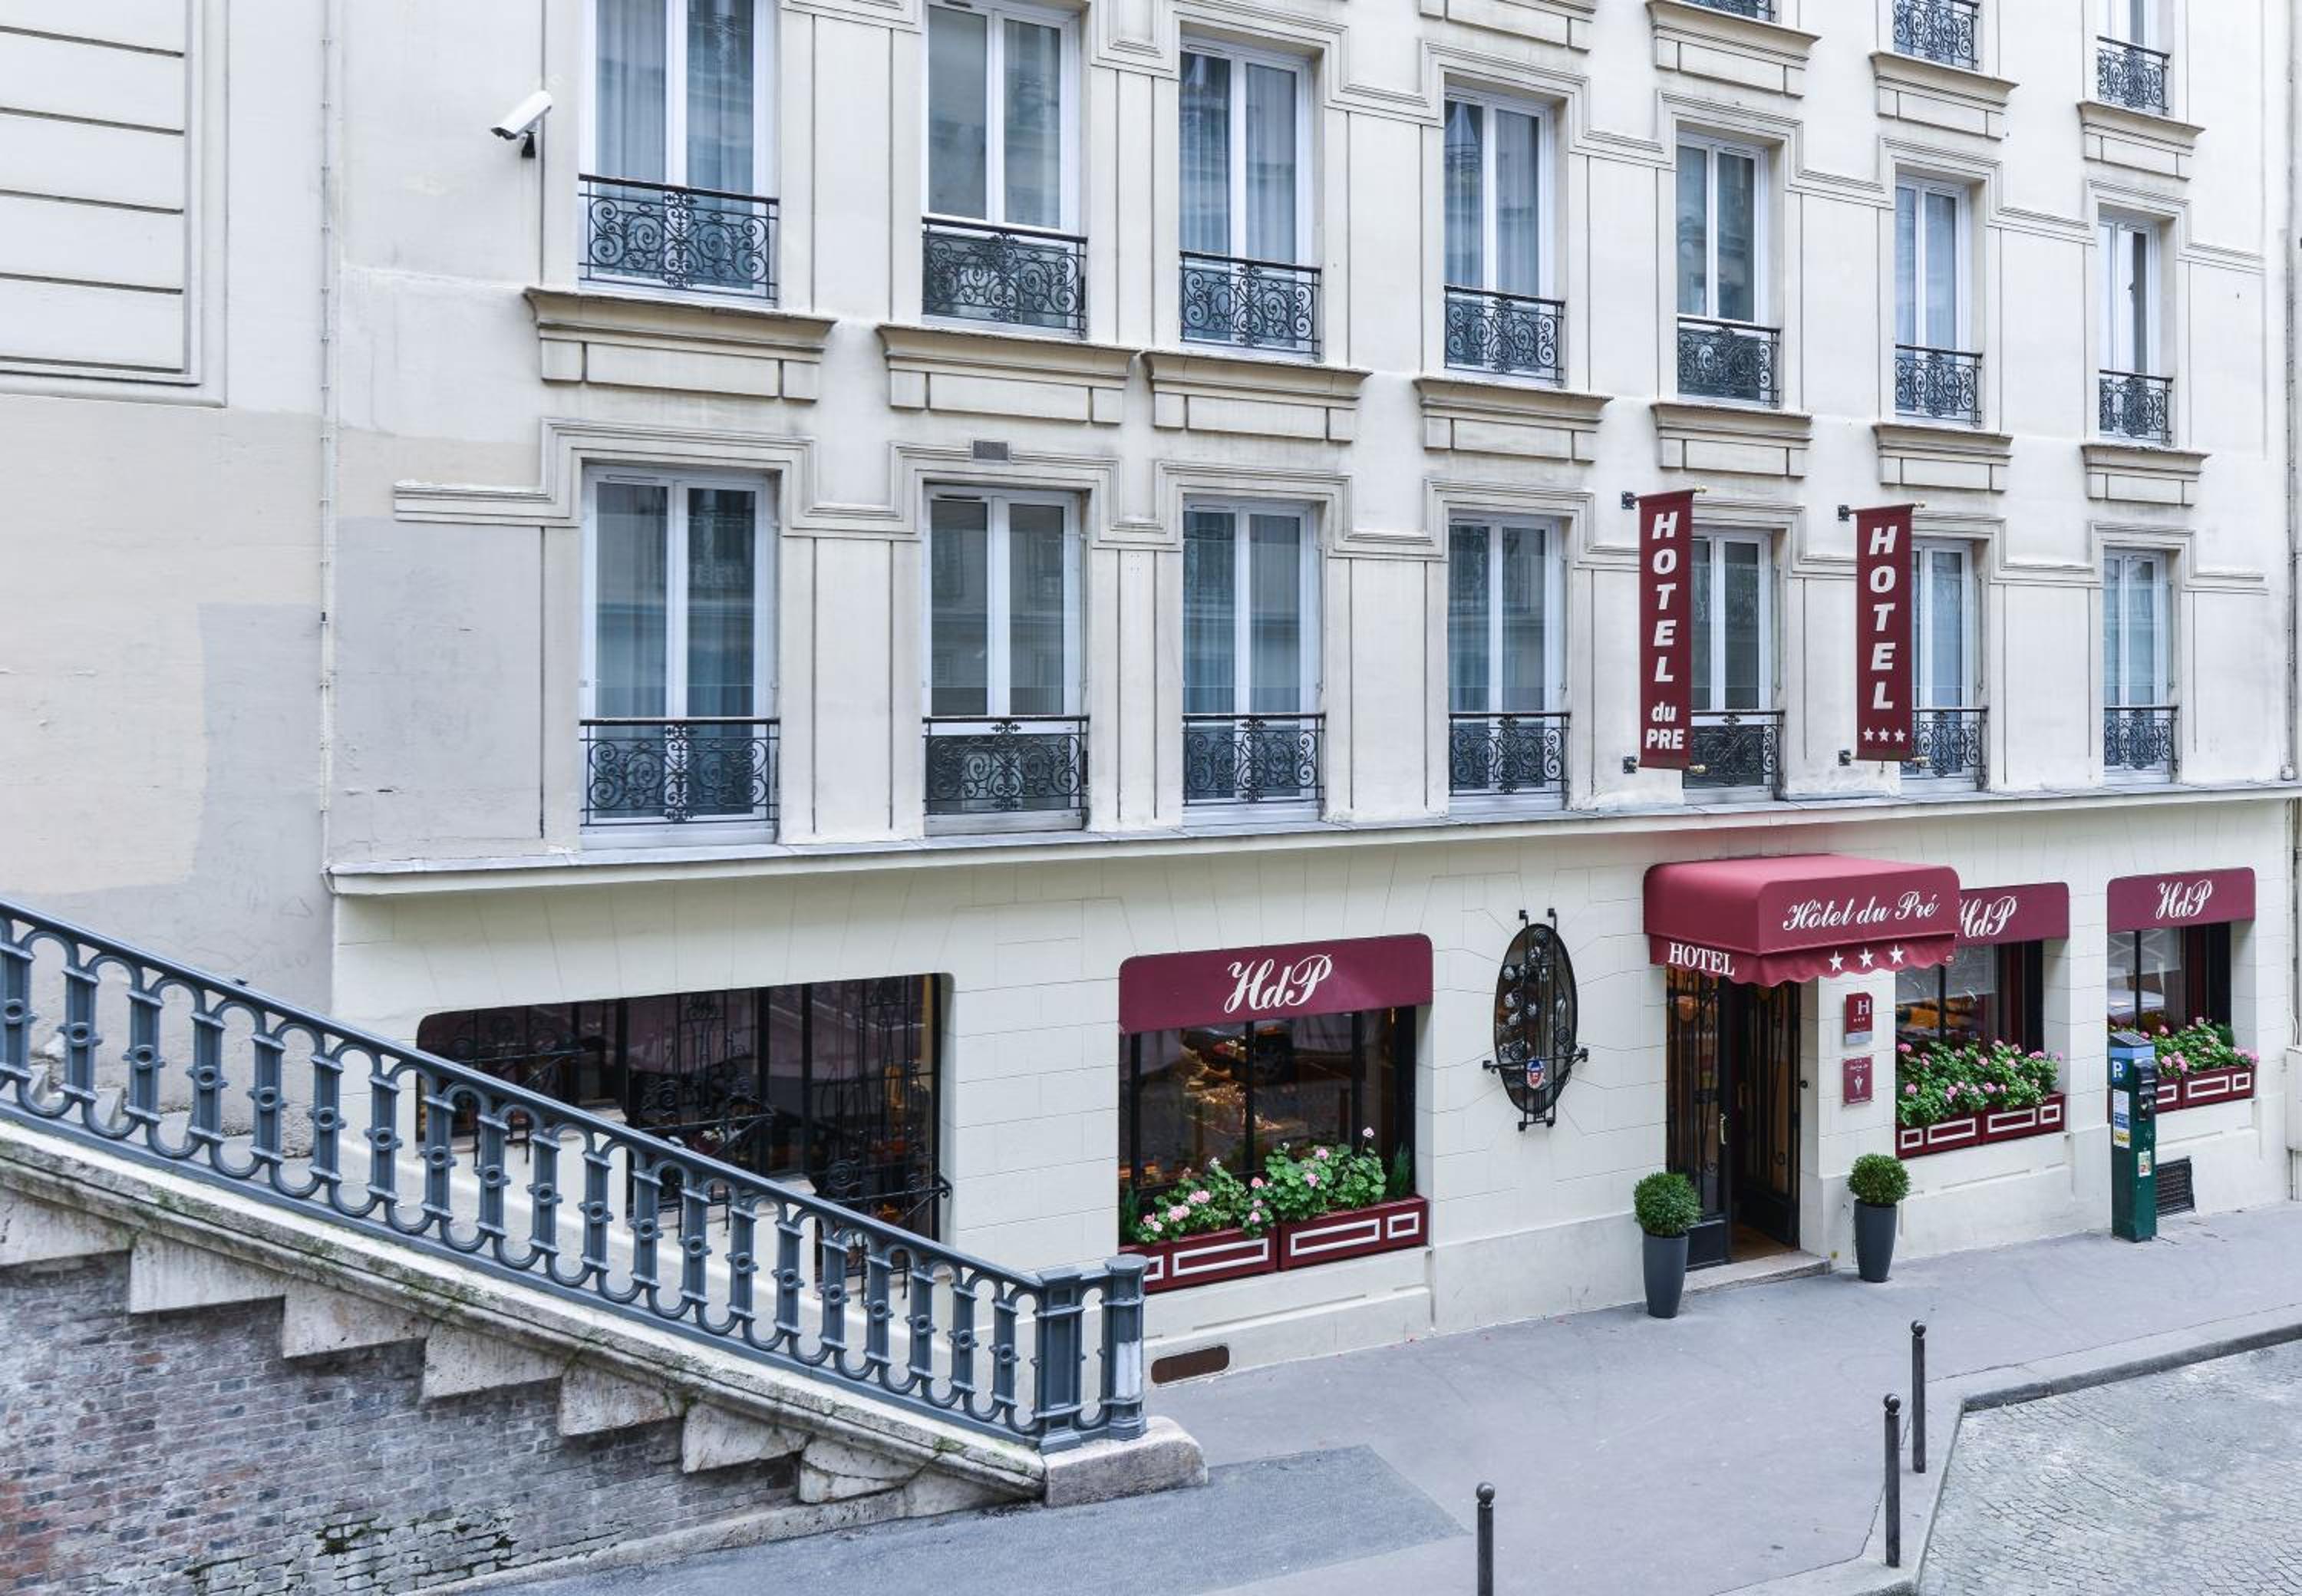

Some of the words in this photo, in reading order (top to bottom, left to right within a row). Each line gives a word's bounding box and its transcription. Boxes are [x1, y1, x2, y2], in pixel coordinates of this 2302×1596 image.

[1652, 511, 1678, 682] HOTEL
[1868, 526, 1897, 710] HOTEL
[1651, 701, 1677, 721] du
[1645, 728, 1684, 750] PRE
[1783, 897, 1855, 931] Hôtel
[1856, 895, 1892, 925] du
[1895, 891, 1941, 920] Pré
[2155, 879, 2213, 919] HdP
[1667, 941, 1735, 977] HOTEL
[1224, 954, 1333, 1014] HdP
[1858, 999, 1870, 1015] H
